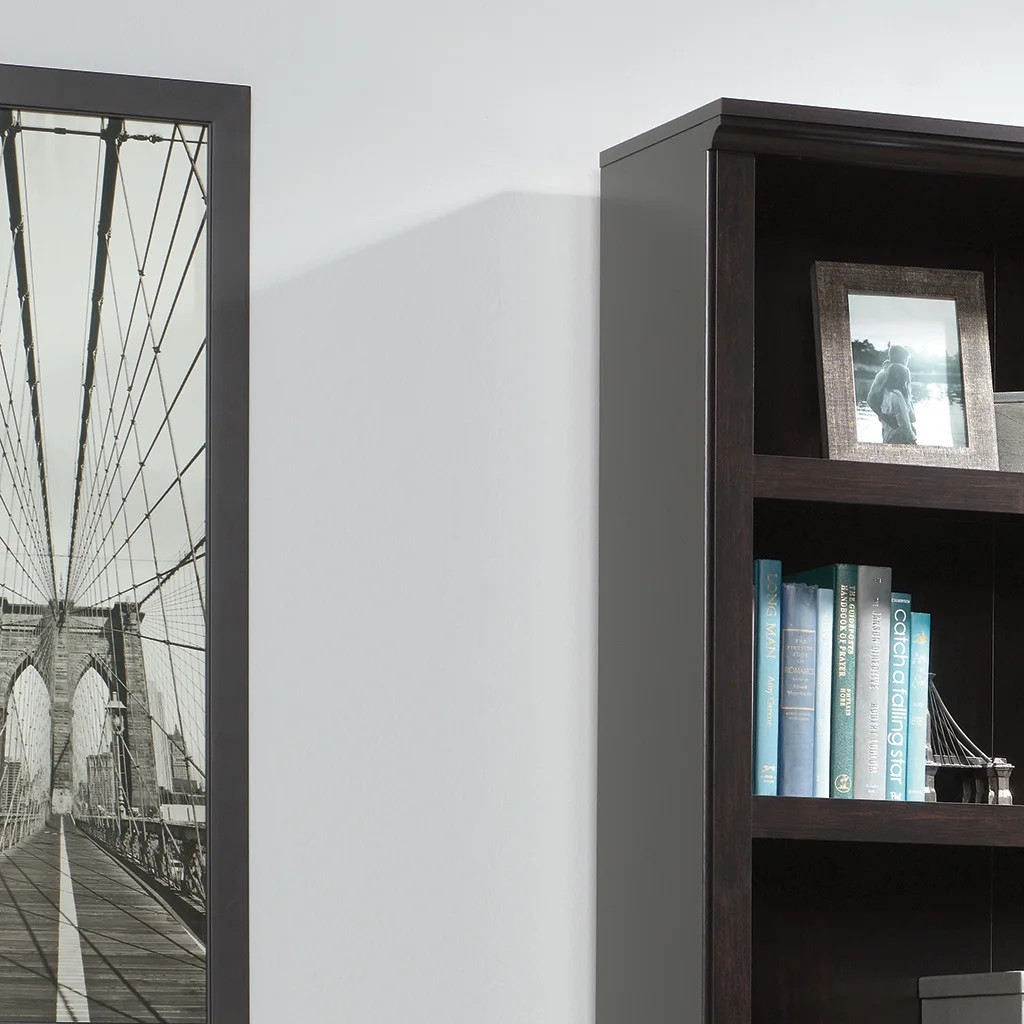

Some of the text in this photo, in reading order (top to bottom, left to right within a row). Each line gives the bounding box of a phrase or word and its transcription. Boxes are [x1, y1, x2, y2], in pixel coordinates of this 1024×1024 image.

[766, 574, 778, 659] LONG MAN
[838, 585, 848, 677] HANDBOOK OF PRAYER
[893, 609, 908, 667] catch
[766, 676, 775, 696] Amy
[892, 670, 904, 684] a
[888, 688, 908, 746] falling
[890, 750, 905, 785] star
